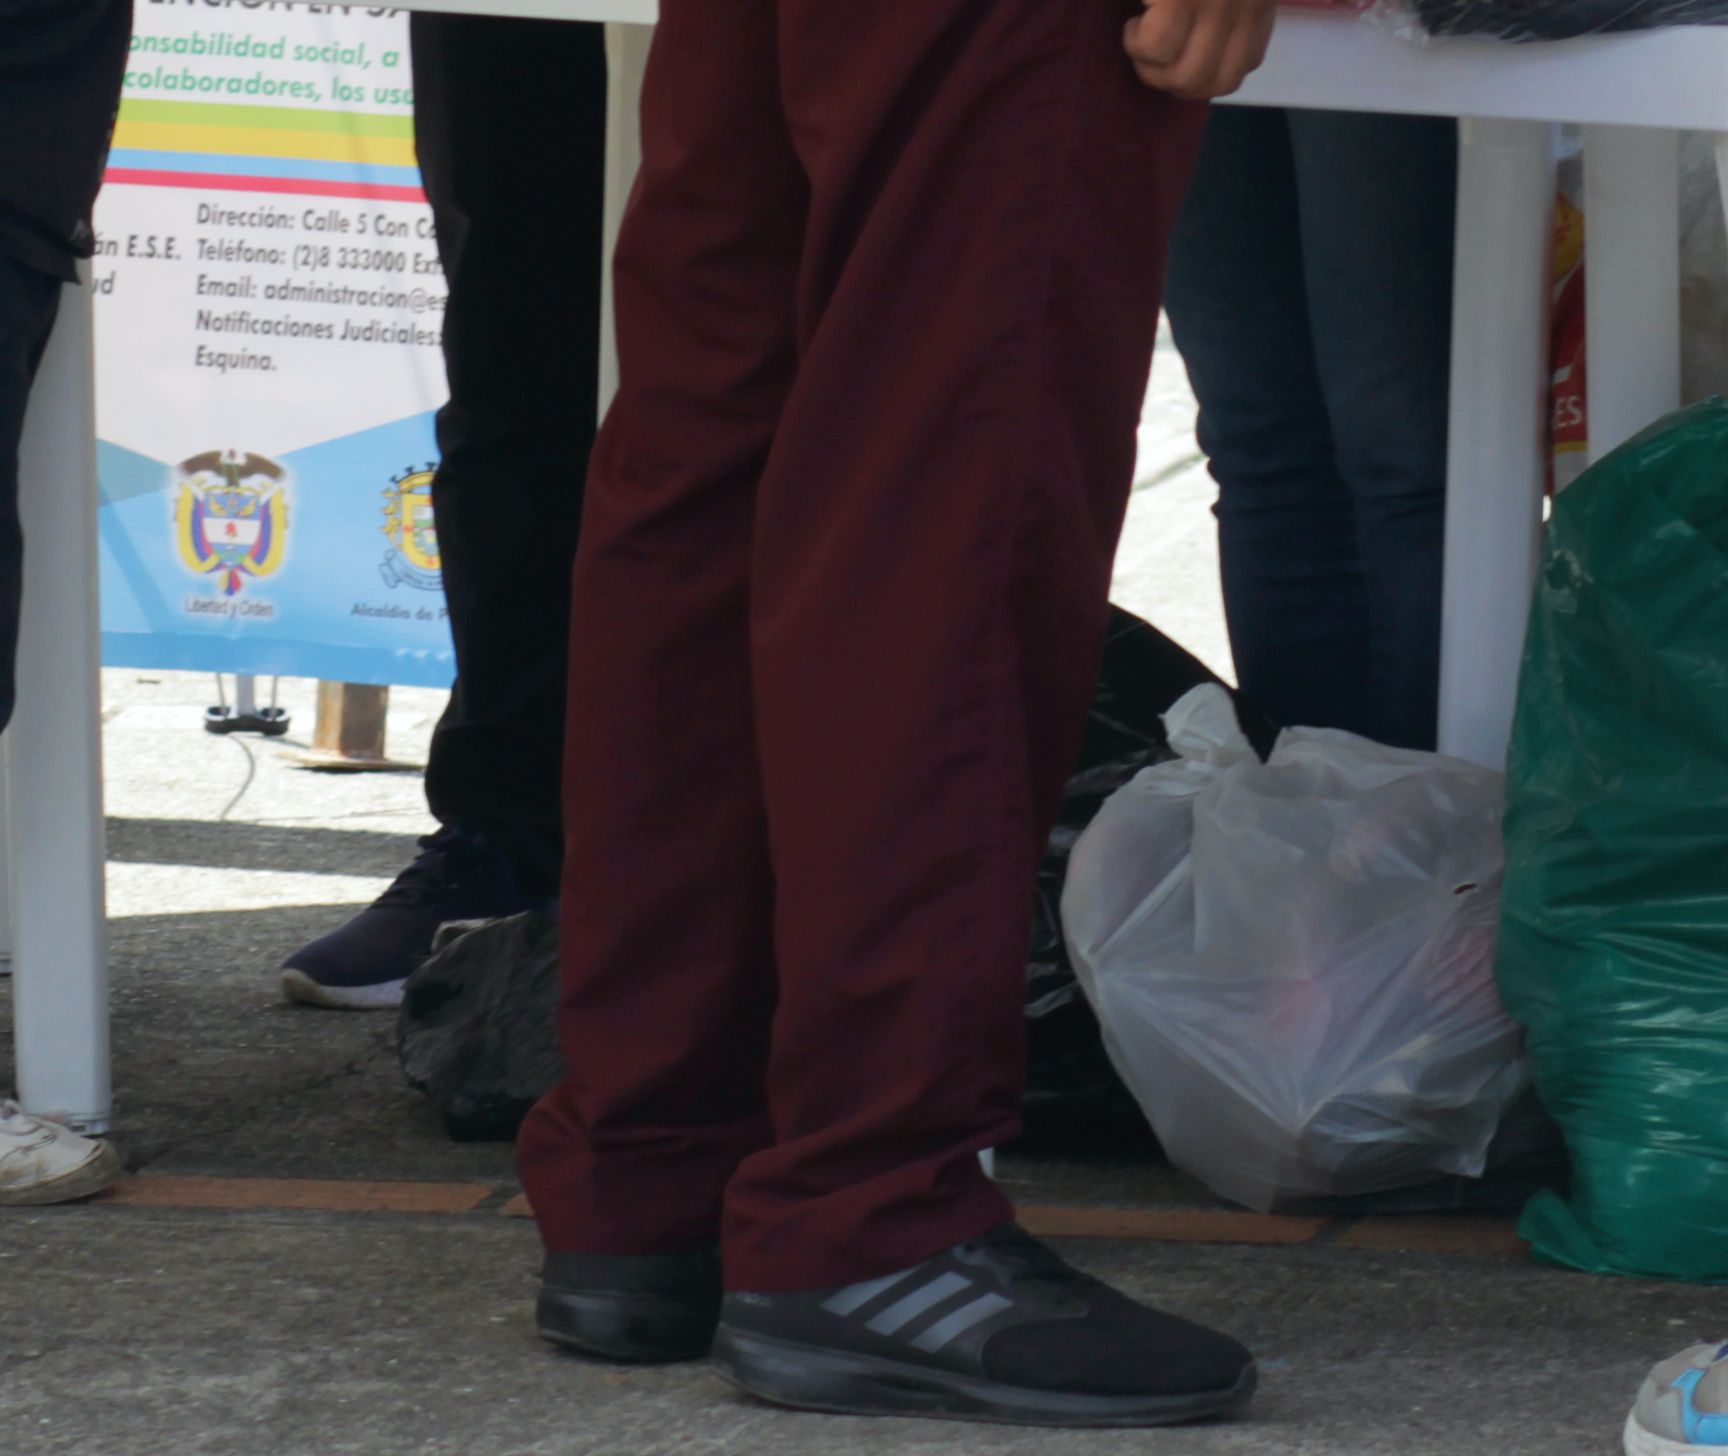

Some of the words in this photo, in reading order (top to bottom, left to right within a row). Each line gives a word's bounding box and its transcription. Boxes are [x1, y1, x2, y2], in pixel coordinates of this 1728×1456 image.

[292, 41, 372, 70] social,
[381, 50, 400, 68] a
[123, 65, 322, 103] colaboradores,
[330, 76, 365, 103] los
[196, 202, 295, 230] Dirección:
[301, 208, 351, 234] Calle
[356, 212, 368, 235] 5
[373, 214, 410, 238] Con
[125, 234, 183, 261] E.S.E.
[197, 237, 286, 265] Teléfono:
[292, 244, 331, 272] (2)8
[336, 246, 407, 274] 333000
[195, 273, 257, 299] Email:
[194, 344, 278, 375] Esquina.
